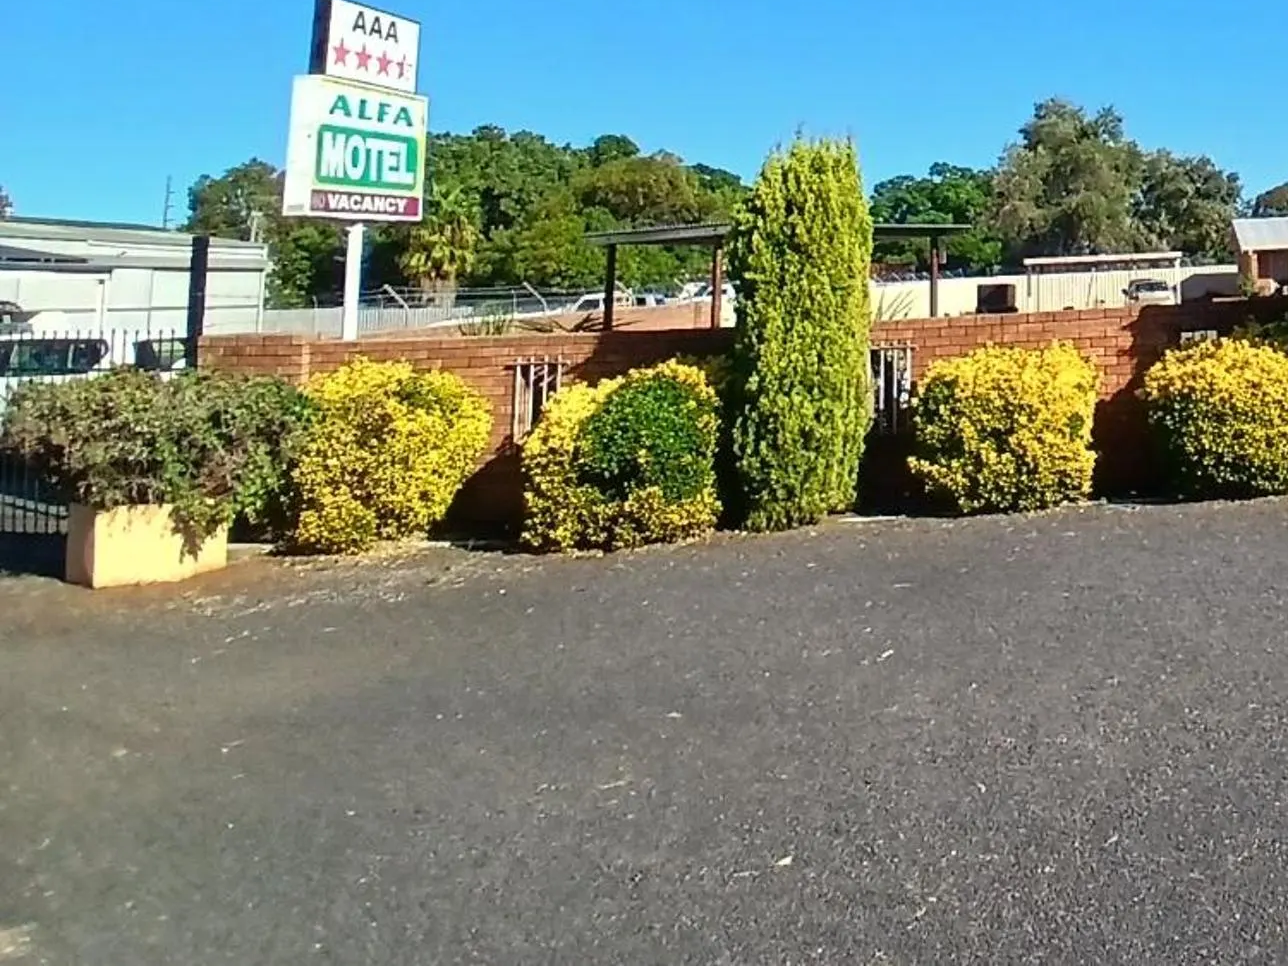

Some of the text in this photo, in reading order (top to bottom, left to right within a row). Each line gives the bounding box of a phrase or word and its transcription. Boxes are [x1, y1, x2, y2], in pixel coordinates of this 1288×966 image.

[352, 10, 399, 44] AAA
[329, 94, 414, 127] ALFA
[319, 130, 415, 185] MOTEL
[327, 192, 408, 213] VACANCY
